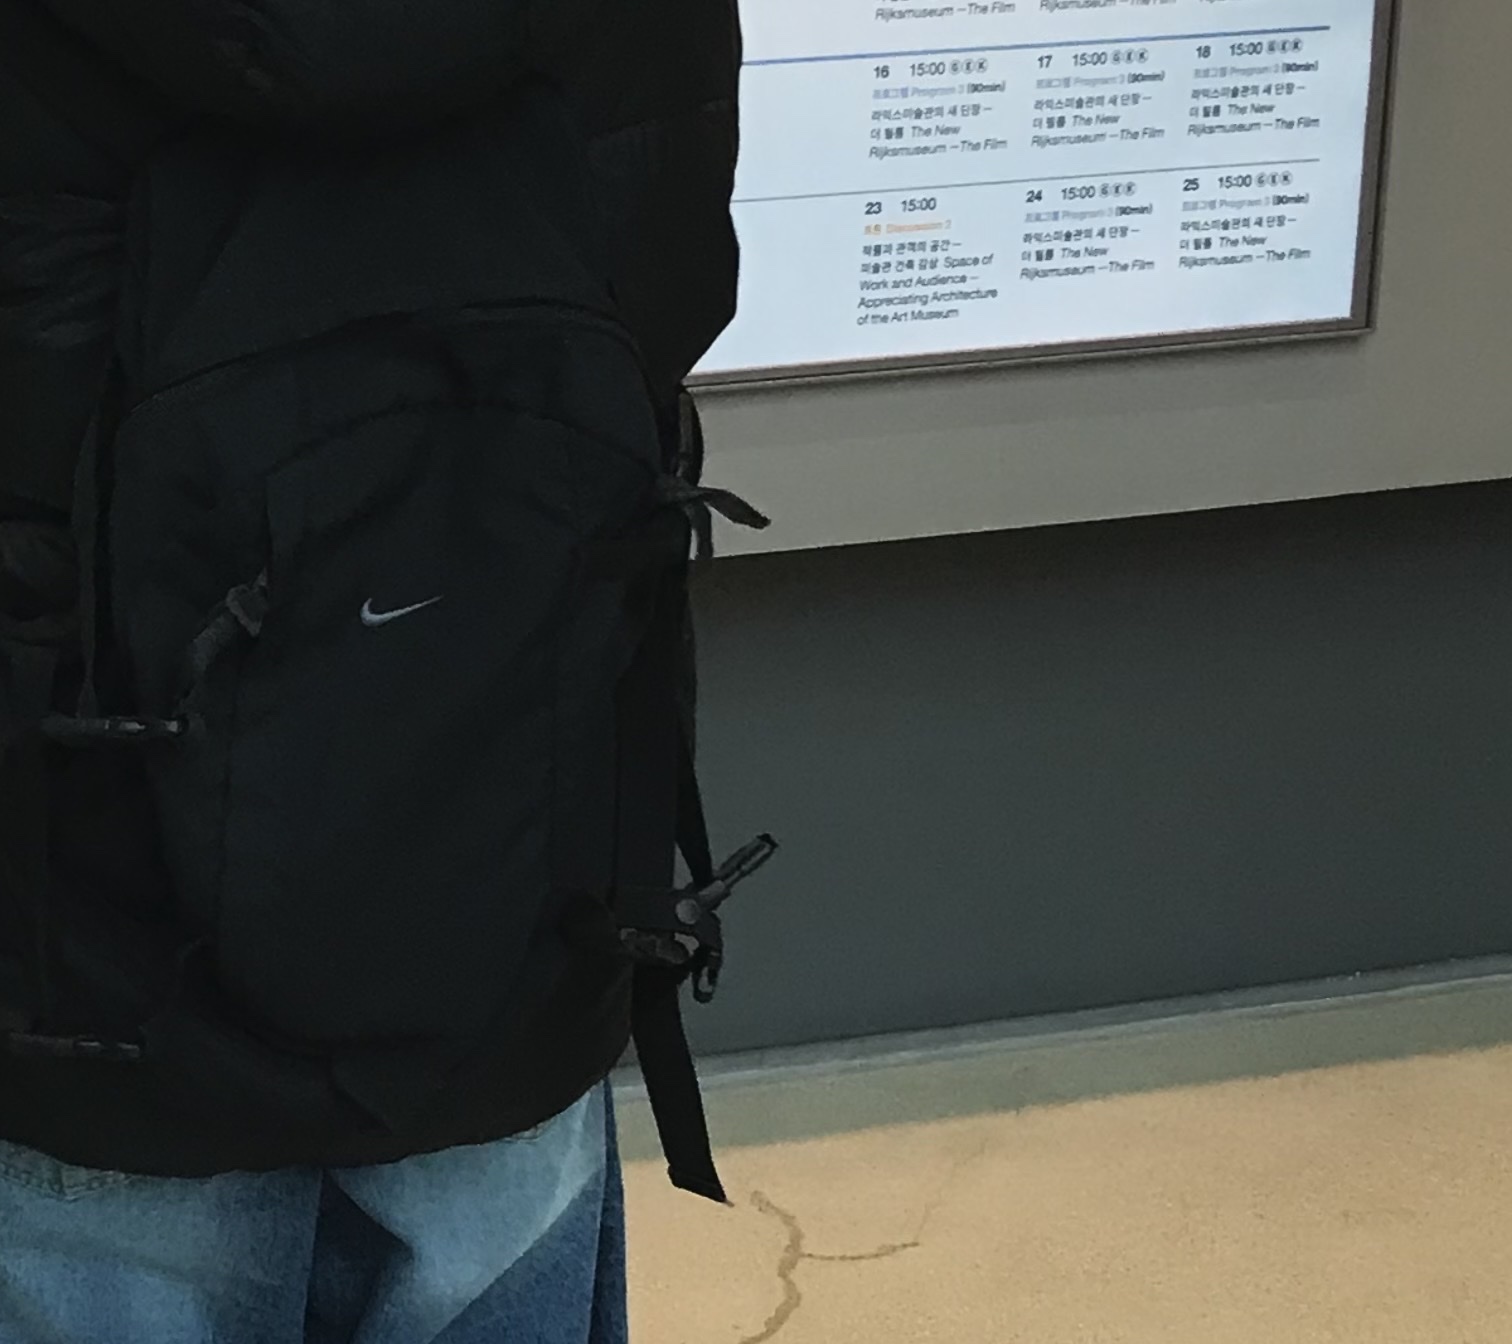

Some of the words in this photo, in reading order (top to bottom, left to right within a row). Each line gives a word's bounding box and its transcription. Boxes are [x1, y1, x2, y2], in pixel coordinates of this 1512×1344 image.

[991, 1, 1015, 13] Film
[1038, 55, 1052, 68] 17
[874, 65, 889, 78] 16
[1218, 174, 1252, 189] 15:00
[901, 197, 936, 212] 15:00
